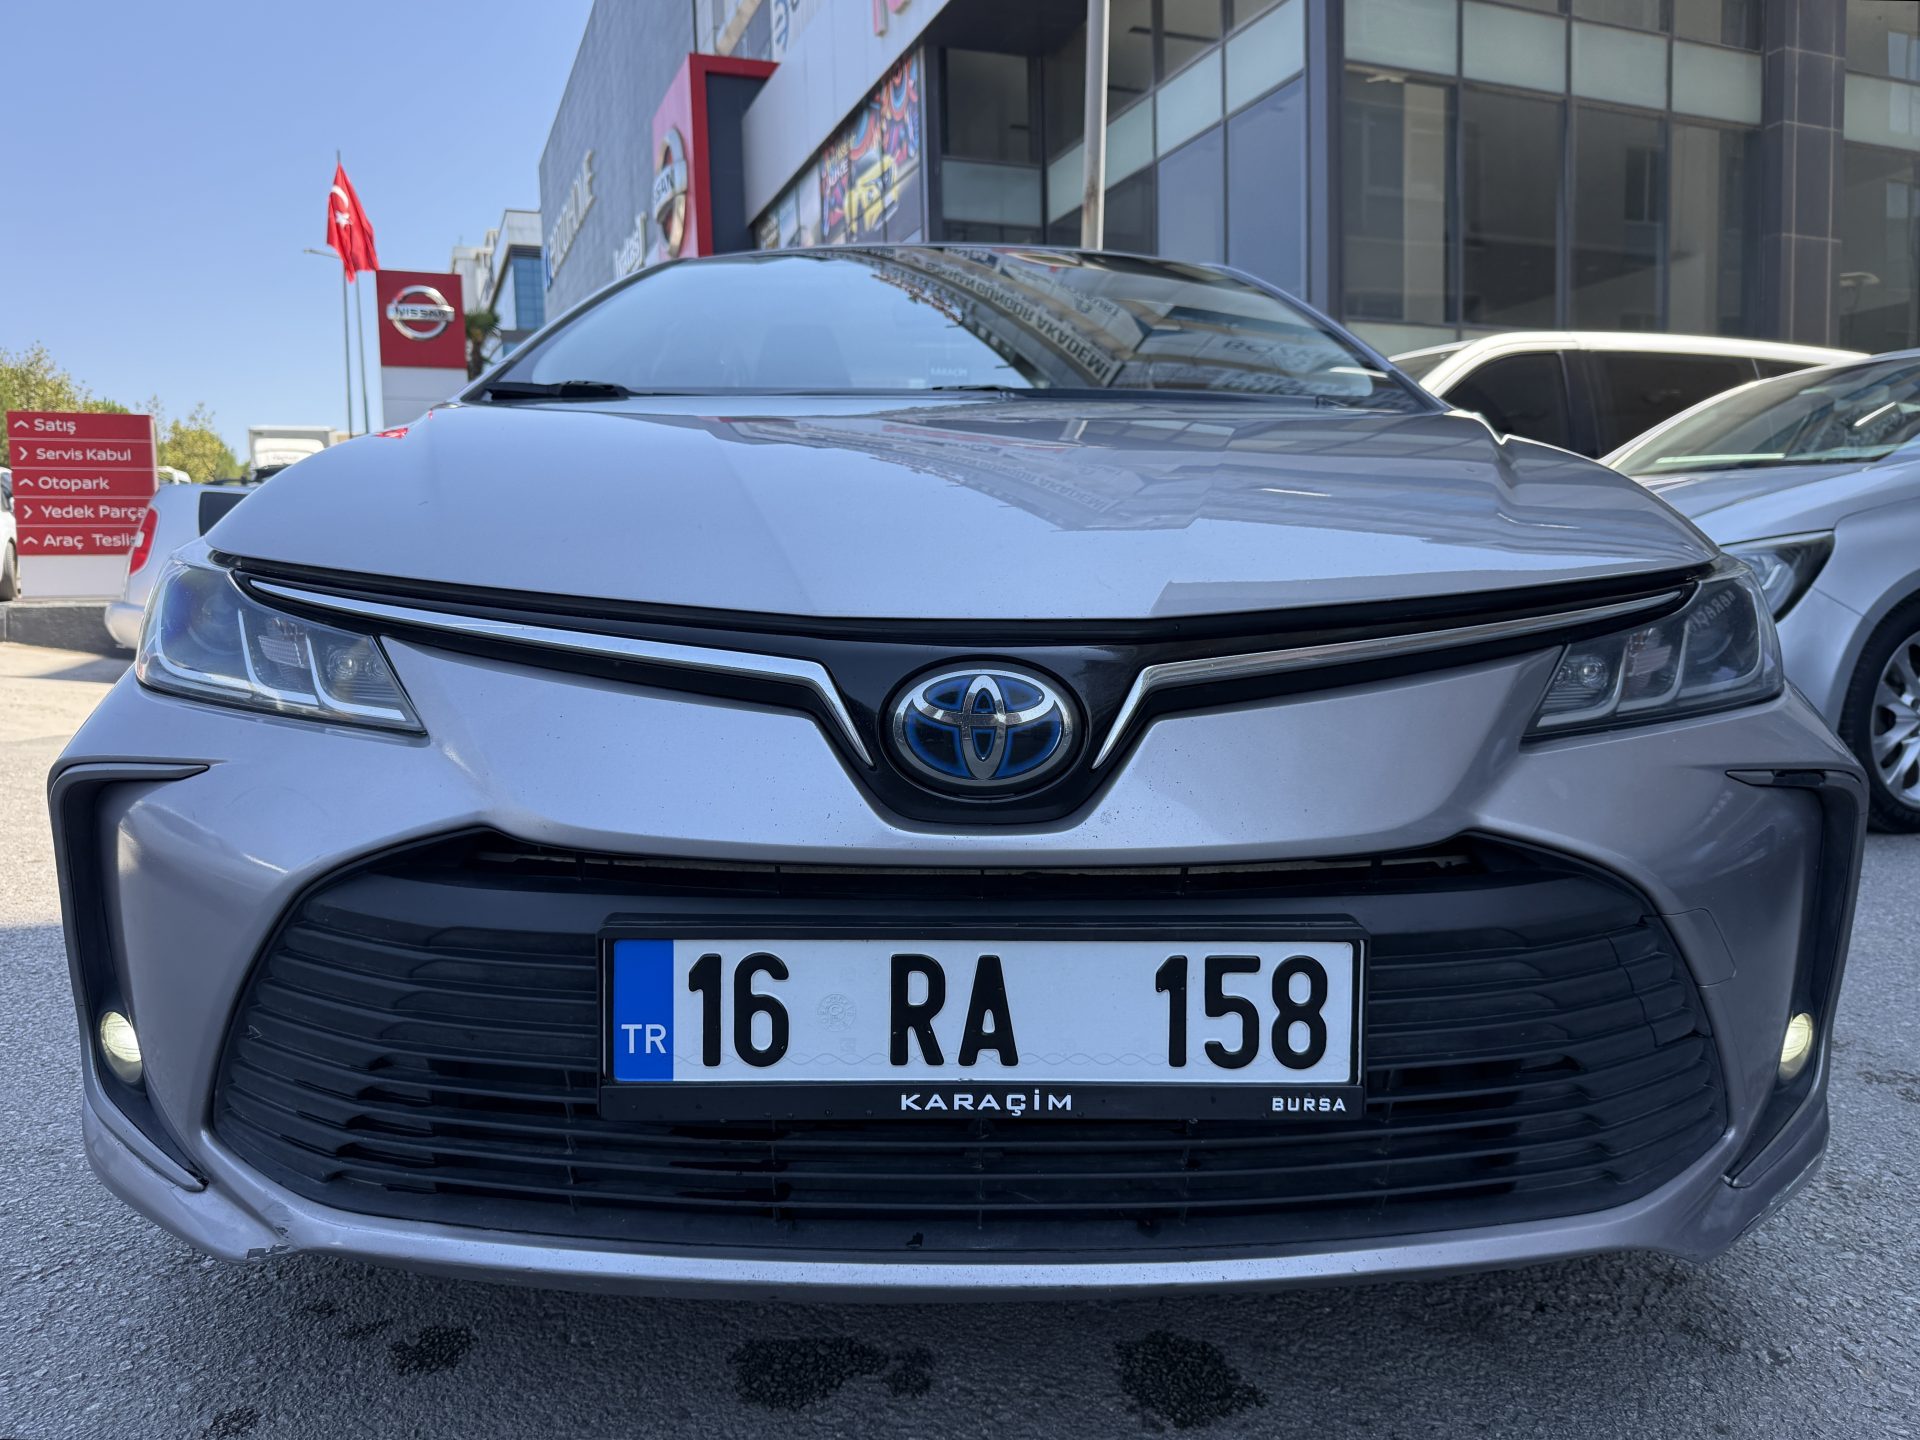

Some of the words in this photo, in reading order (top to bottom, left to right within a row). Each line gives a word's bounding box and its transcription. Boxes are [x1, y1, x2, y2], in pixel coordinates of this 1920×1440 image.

[395, 306, 449, 320] NISSAN
[34, 418, 77, 435] Satış
[36, 447, 83, 460] Servis
[87, 448, 132, 461] Kabul
[38, 476, 111, 492] Otopark
[41, 505, 95, 519] Yedek
[100, 506, 147, 521] Parça
[44, 534, 84, 549] Araç
[92, 533, 137, 547] Tesli
[688, 952, 790, 1068] 16
[890, 953, 1019, 1069] RA
[1155, 954, 1329, 1070] 158
[622, 1025, 667, 1055] TR
[900, 1092, 1074, 1117] KARAÇİM
[1271, 1097, 1347, 1112] BURSA
